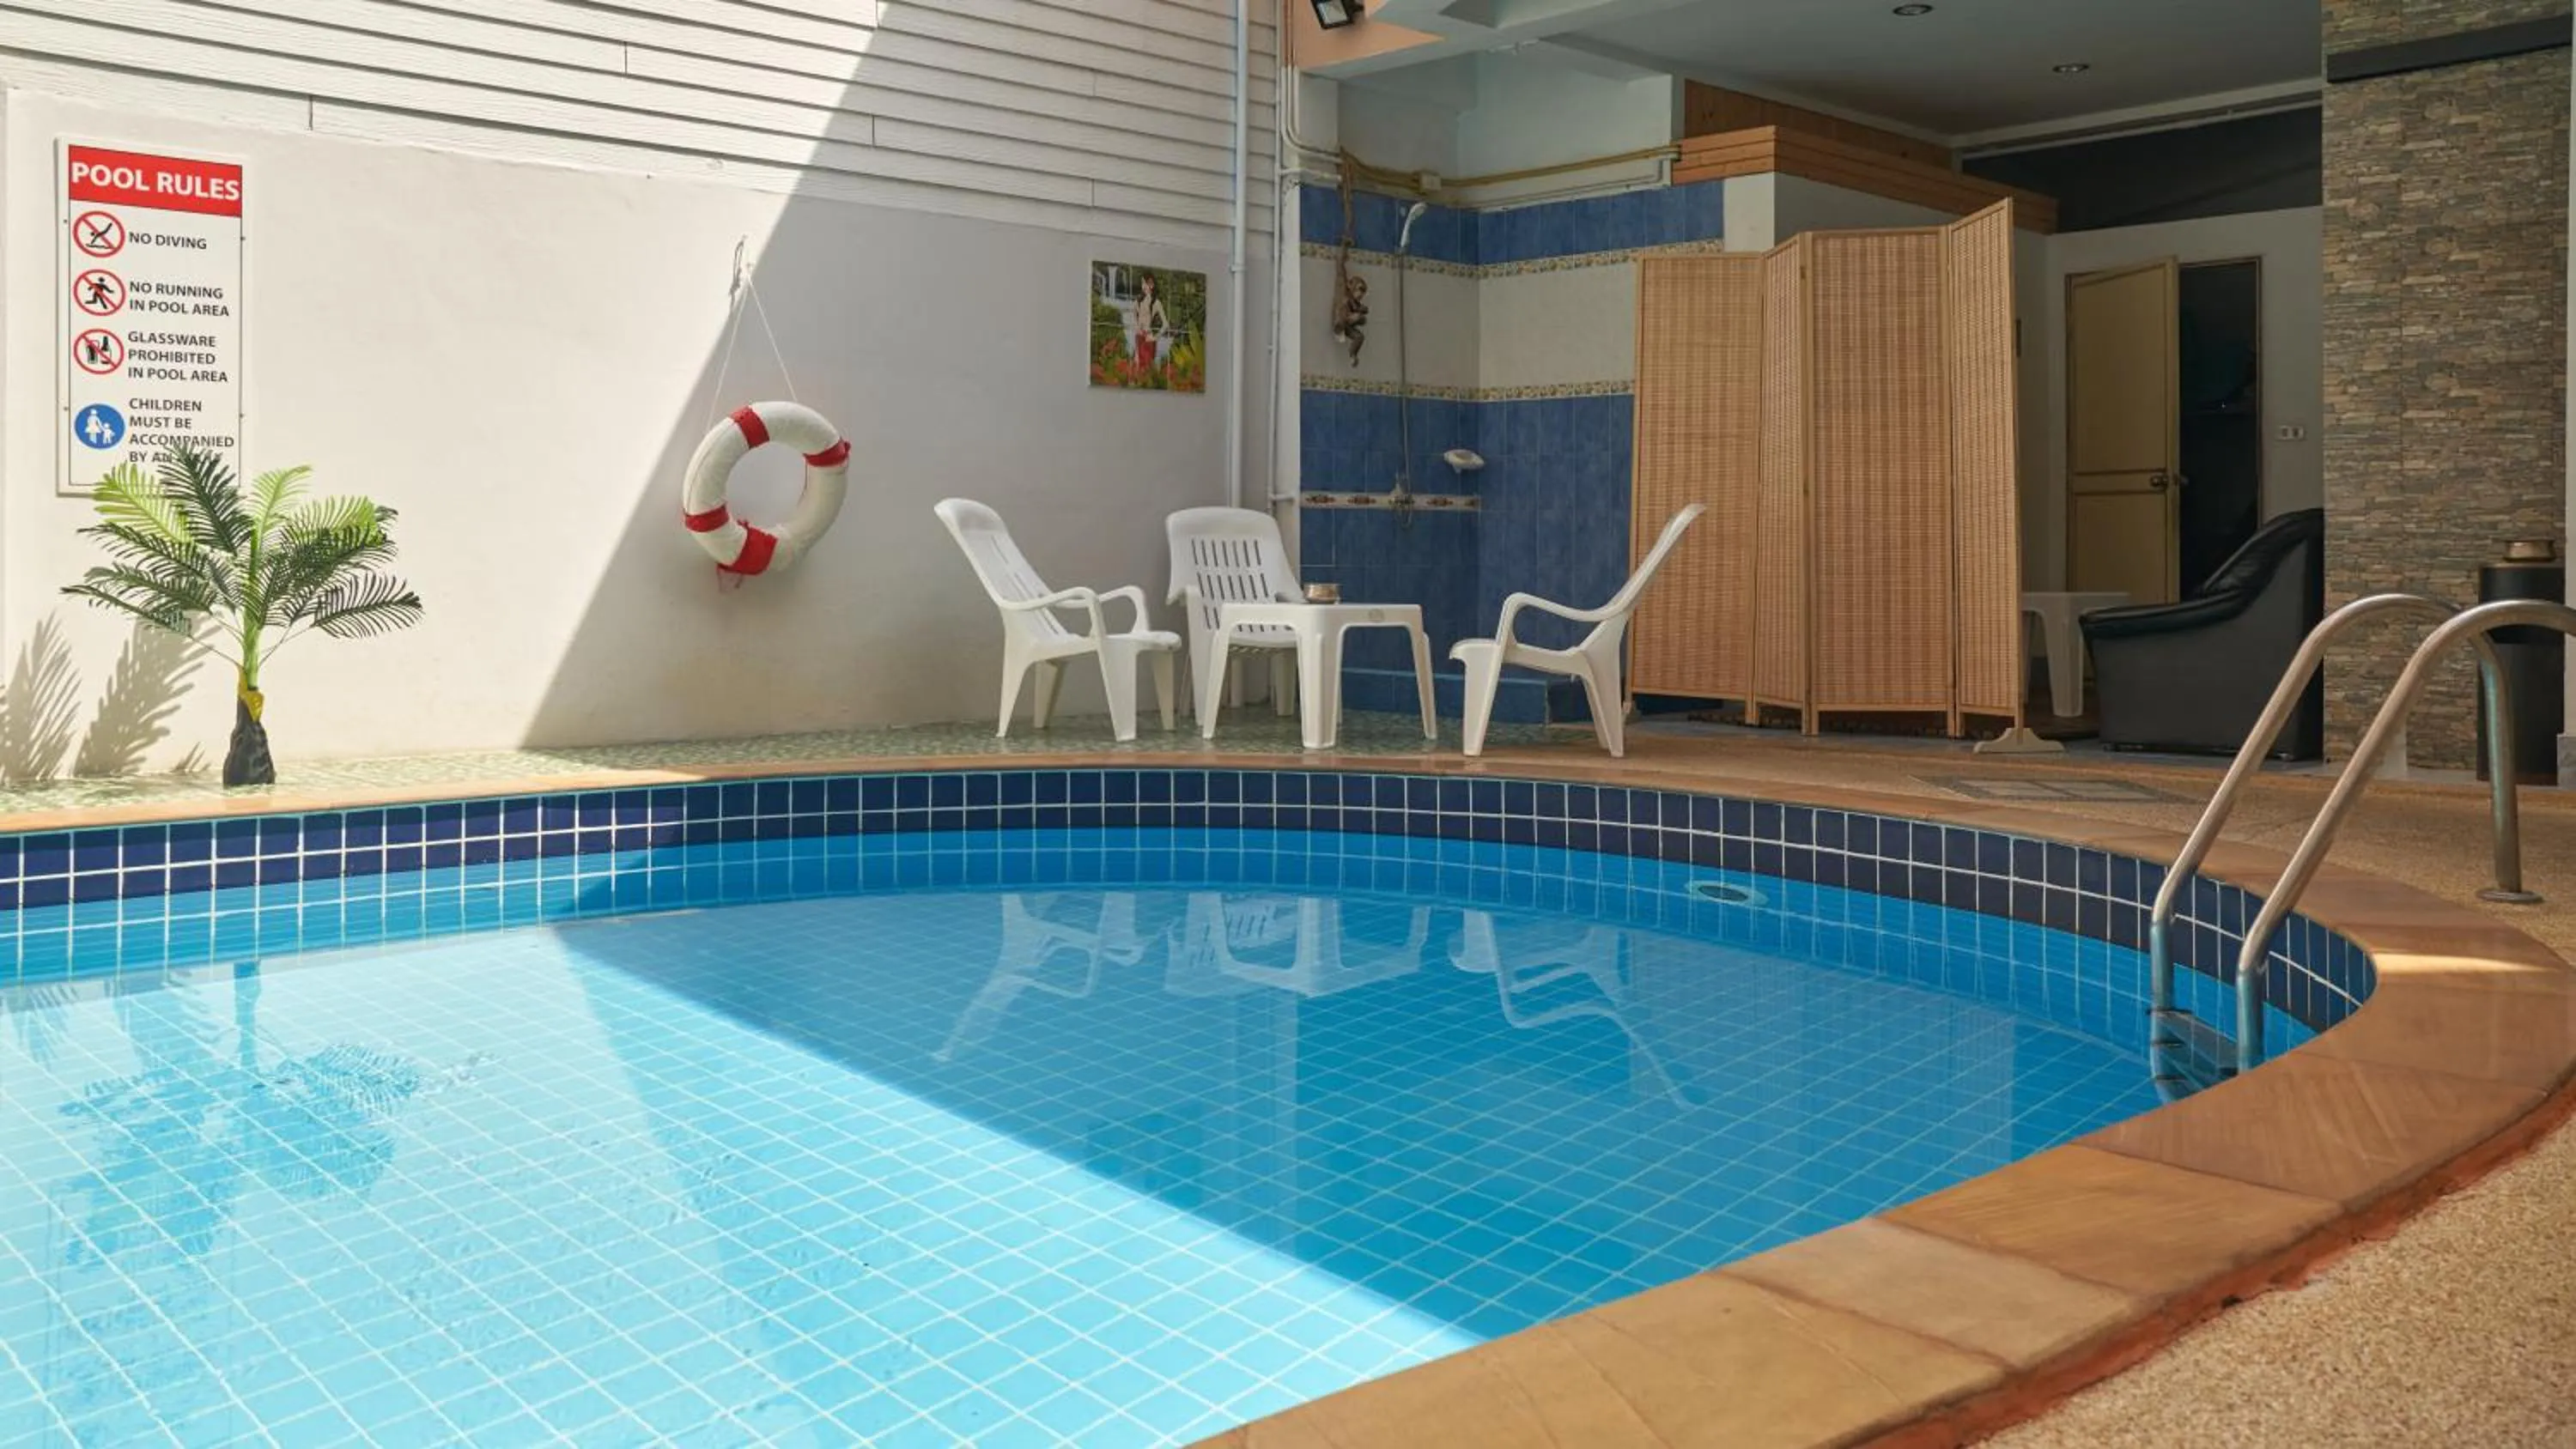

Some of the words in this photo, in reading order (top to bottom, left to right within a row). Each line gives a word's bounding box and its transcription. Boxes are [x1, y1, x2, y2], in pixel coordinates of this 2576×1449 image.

[71, 161, 150, 191] POOL
[156, 172, 240, 201] RULES
[129, 232, 152, 245] NO
[155, 234, 207, 250] DIVING
[129, 282, 152, 294] NO
[155, 282, 223, 300] RUNNING
[129, 300, 145, 312] IN
[149, 300, 189, 315] POOL
[191, 304, 229, 317] AREA
[128, 330, 216, 348] GLASSWARE
[129, 349, 216, 365] PROHIBITED
[129, 367, 144, 379] IN
[148, 367, 187, 381] POOL
[190, 370, 228, 383] AREA
[129, 397, 203, 413] CHILDREN
[129, 415, 172, 428] MUST
[174, 416, 191, 429] BE
[129, 433, 234, 448] ACCOMPANIED
[129, 451, 148, 463] BY
